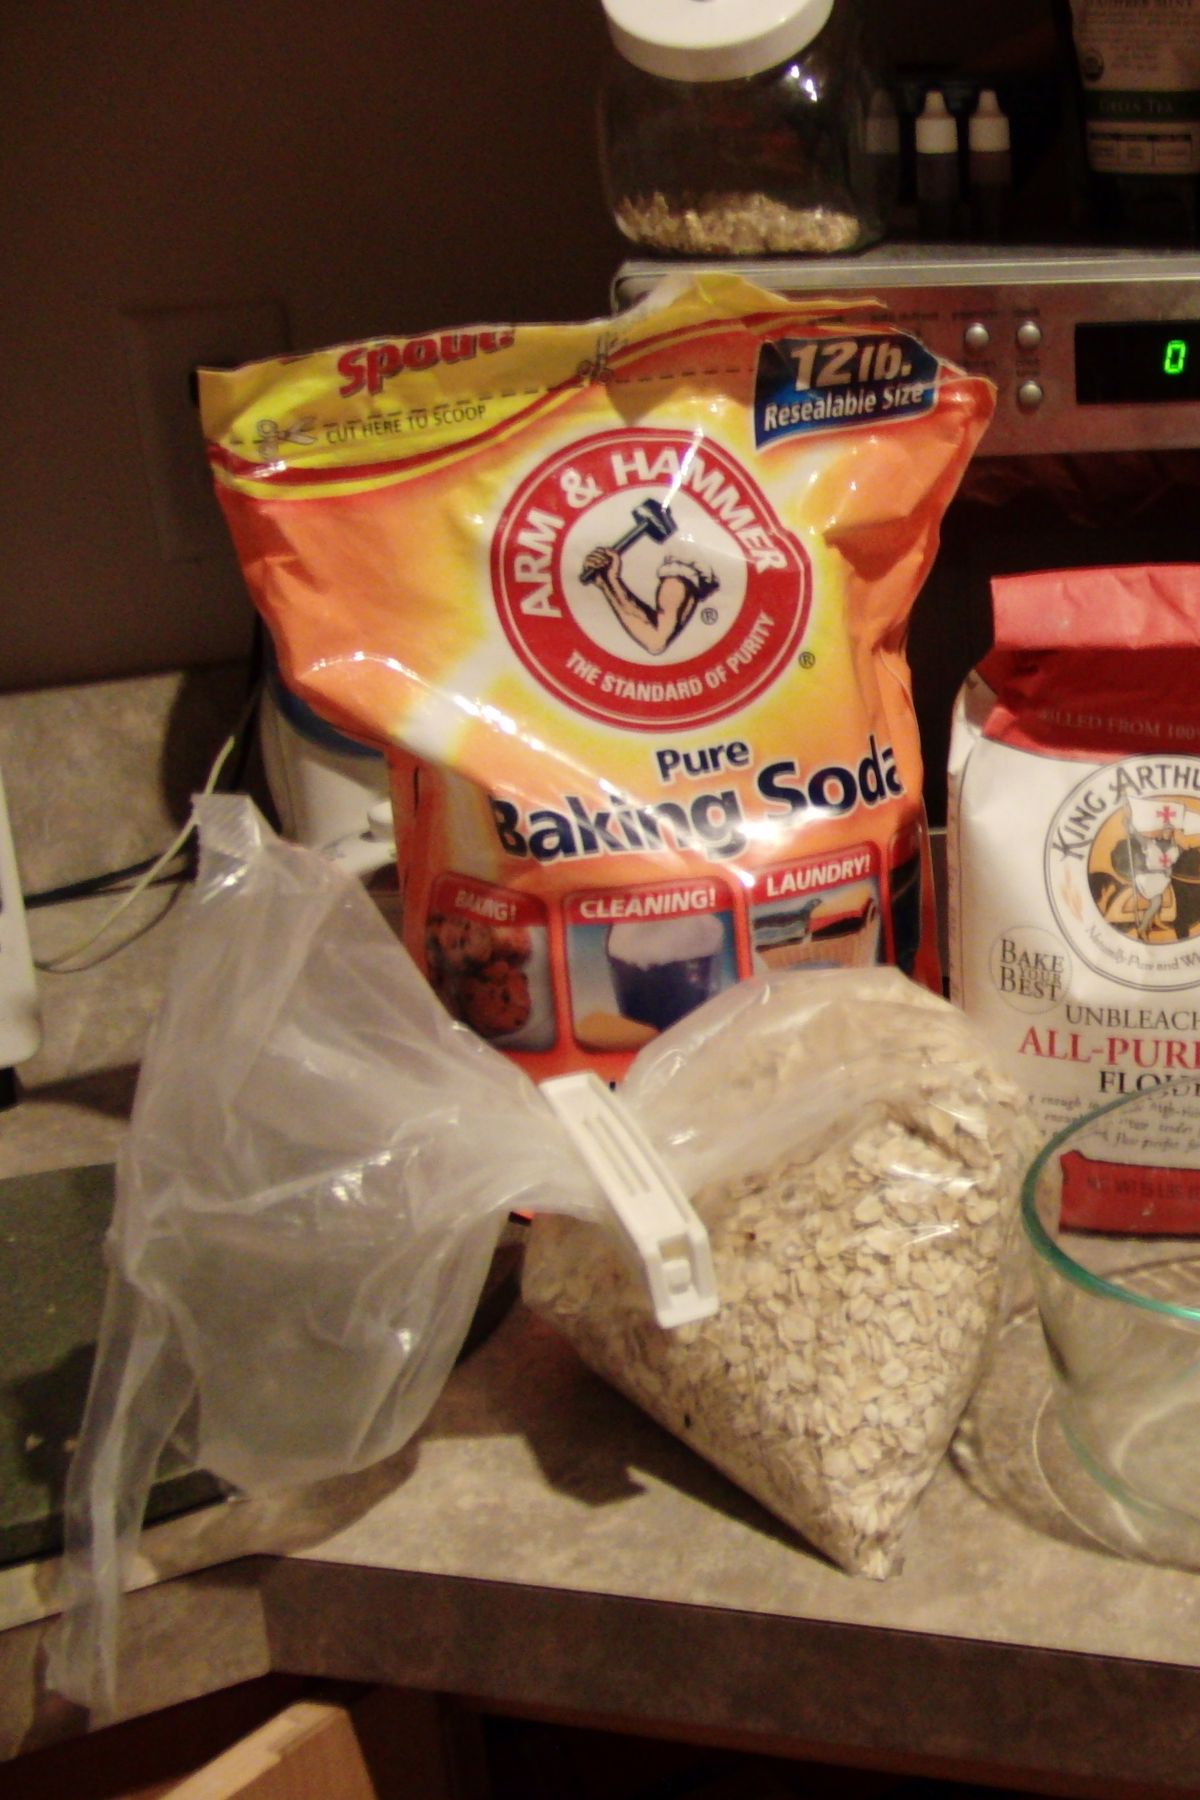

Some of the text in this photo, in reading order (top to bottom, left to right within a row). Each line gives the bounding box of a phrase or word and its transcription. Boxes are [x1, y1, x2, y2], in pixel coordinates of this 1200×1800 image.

[790, 341, 912, 392] 12 lb.
[1163, 339, 1186, 375] 0
[325, 405, 486, 444] CUT HERE TO SCOOP
[764, 383, 924, 432] Resealable Size
[514, 446, 788, 618] ARM & HAMMER
[565, 610, 776, 702] THE STANDARD OF PURITY
[655, 740, 750, 782] Pure
[492, 735, 905, 860] Baking Soda
[1052, 792, 1106, 860] KING
[766, 858, 871, 898] LAUNDRY!
[579, 888, 717, 919] CLEANING!
[1001, 939, 1065, 973] BAKE
[1156, 957, 1180, 970] and
[1000, 965, 1062, 1002] BEST
